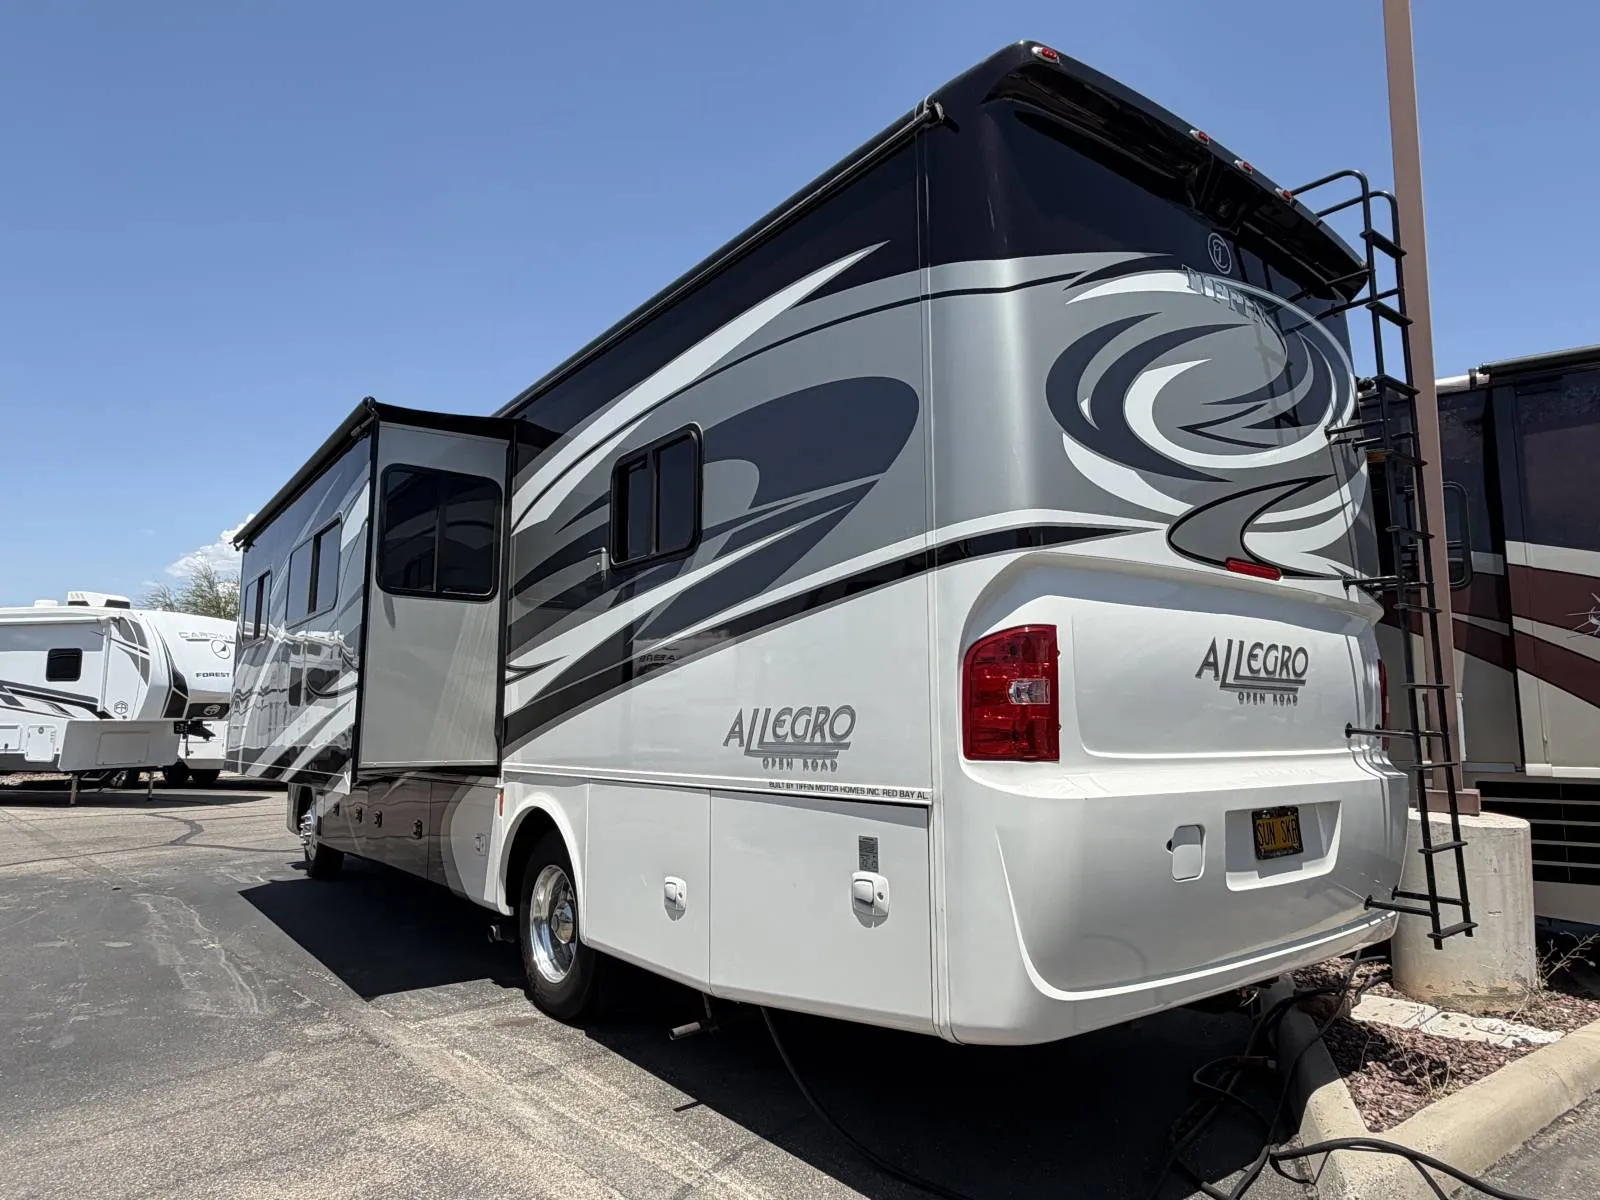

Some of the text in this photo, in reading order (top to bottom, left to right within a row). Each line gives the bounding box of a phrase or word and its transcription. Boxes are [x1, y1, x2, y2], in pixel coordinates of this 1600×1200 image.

[1195, 636, 1309, 694] ALLEGRO
[1238, 691, 1298, 707] OPEN ROAD
[722, 704, 857, 758] ALLEGRO
[762, 756, 838, 773] OPEN ROAD
[768, 781, 785, 790] BUILT
[786, 782, 794, 790] BY
[796, 783, 814, 792] TIFFIN
[815, 784, 839, 793] MOTOR
[840, 785, 865, 795] HOMES
[882, 788, 898, 798] RED
[899, 789, 916, 799] BAY
[1257, 820, 1277, 847] SUN
